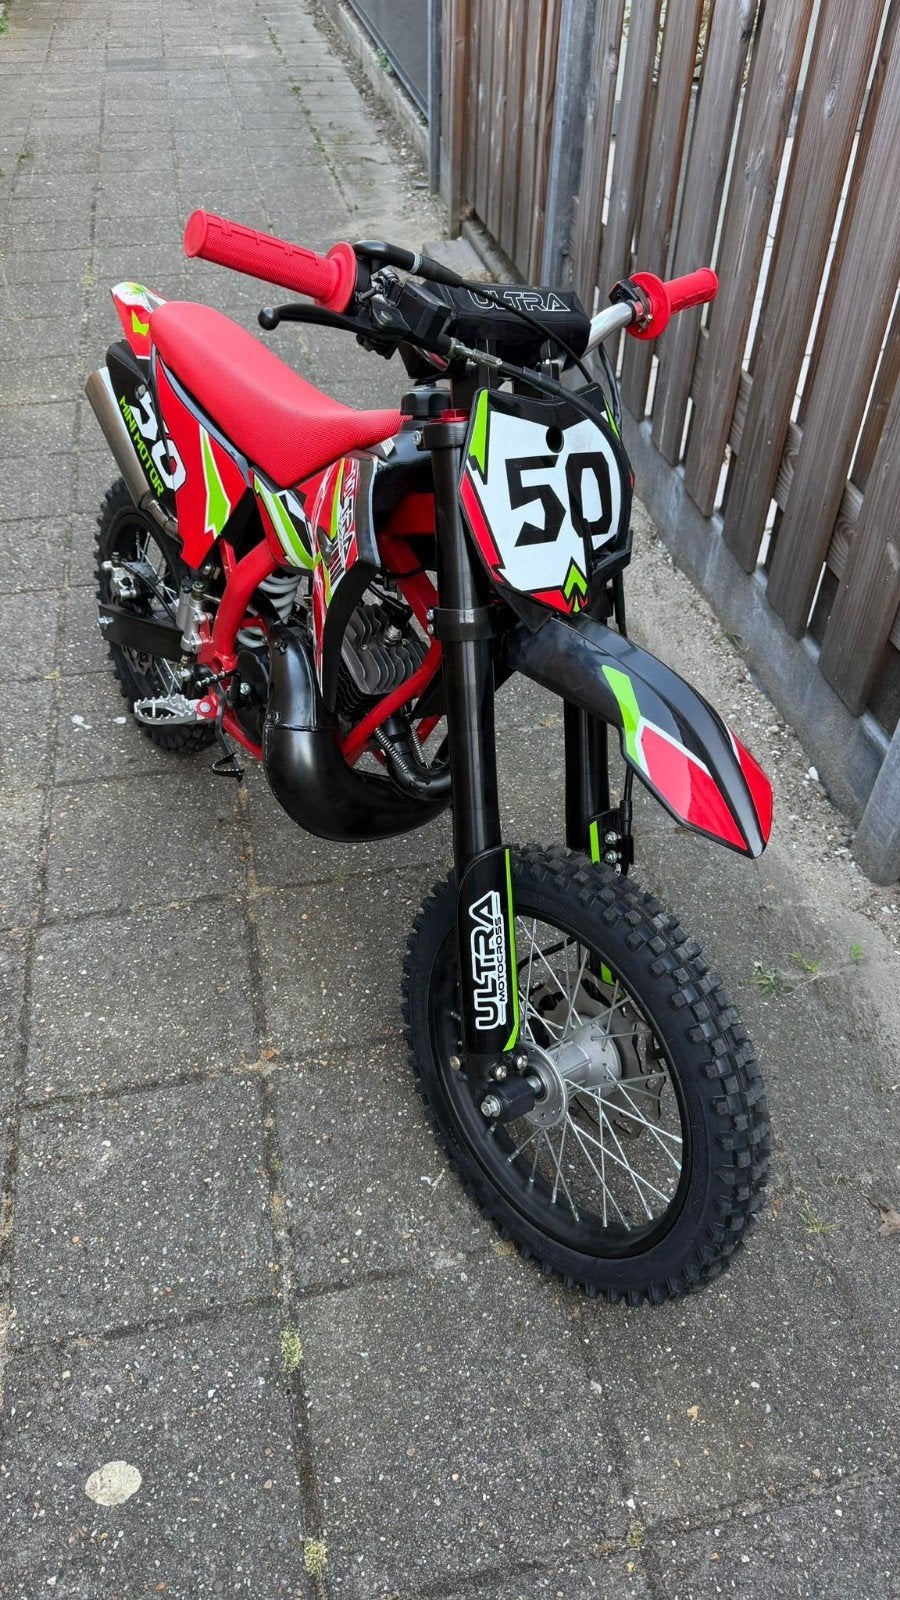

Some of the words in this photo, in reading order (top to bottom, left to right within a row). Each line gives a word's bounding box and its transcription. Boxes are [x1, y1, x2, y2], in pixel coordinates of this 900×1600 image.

[467, 288, 571, 312] ULTRA
[120, 395, 138, 433] MINI
[133, 431, 165, 497] MOTOR
[505, 451, 613, 547] 50
[469, 890, 500, 1030] ULTRA
[495, 916, 506, 1002] MOTOCROSS
